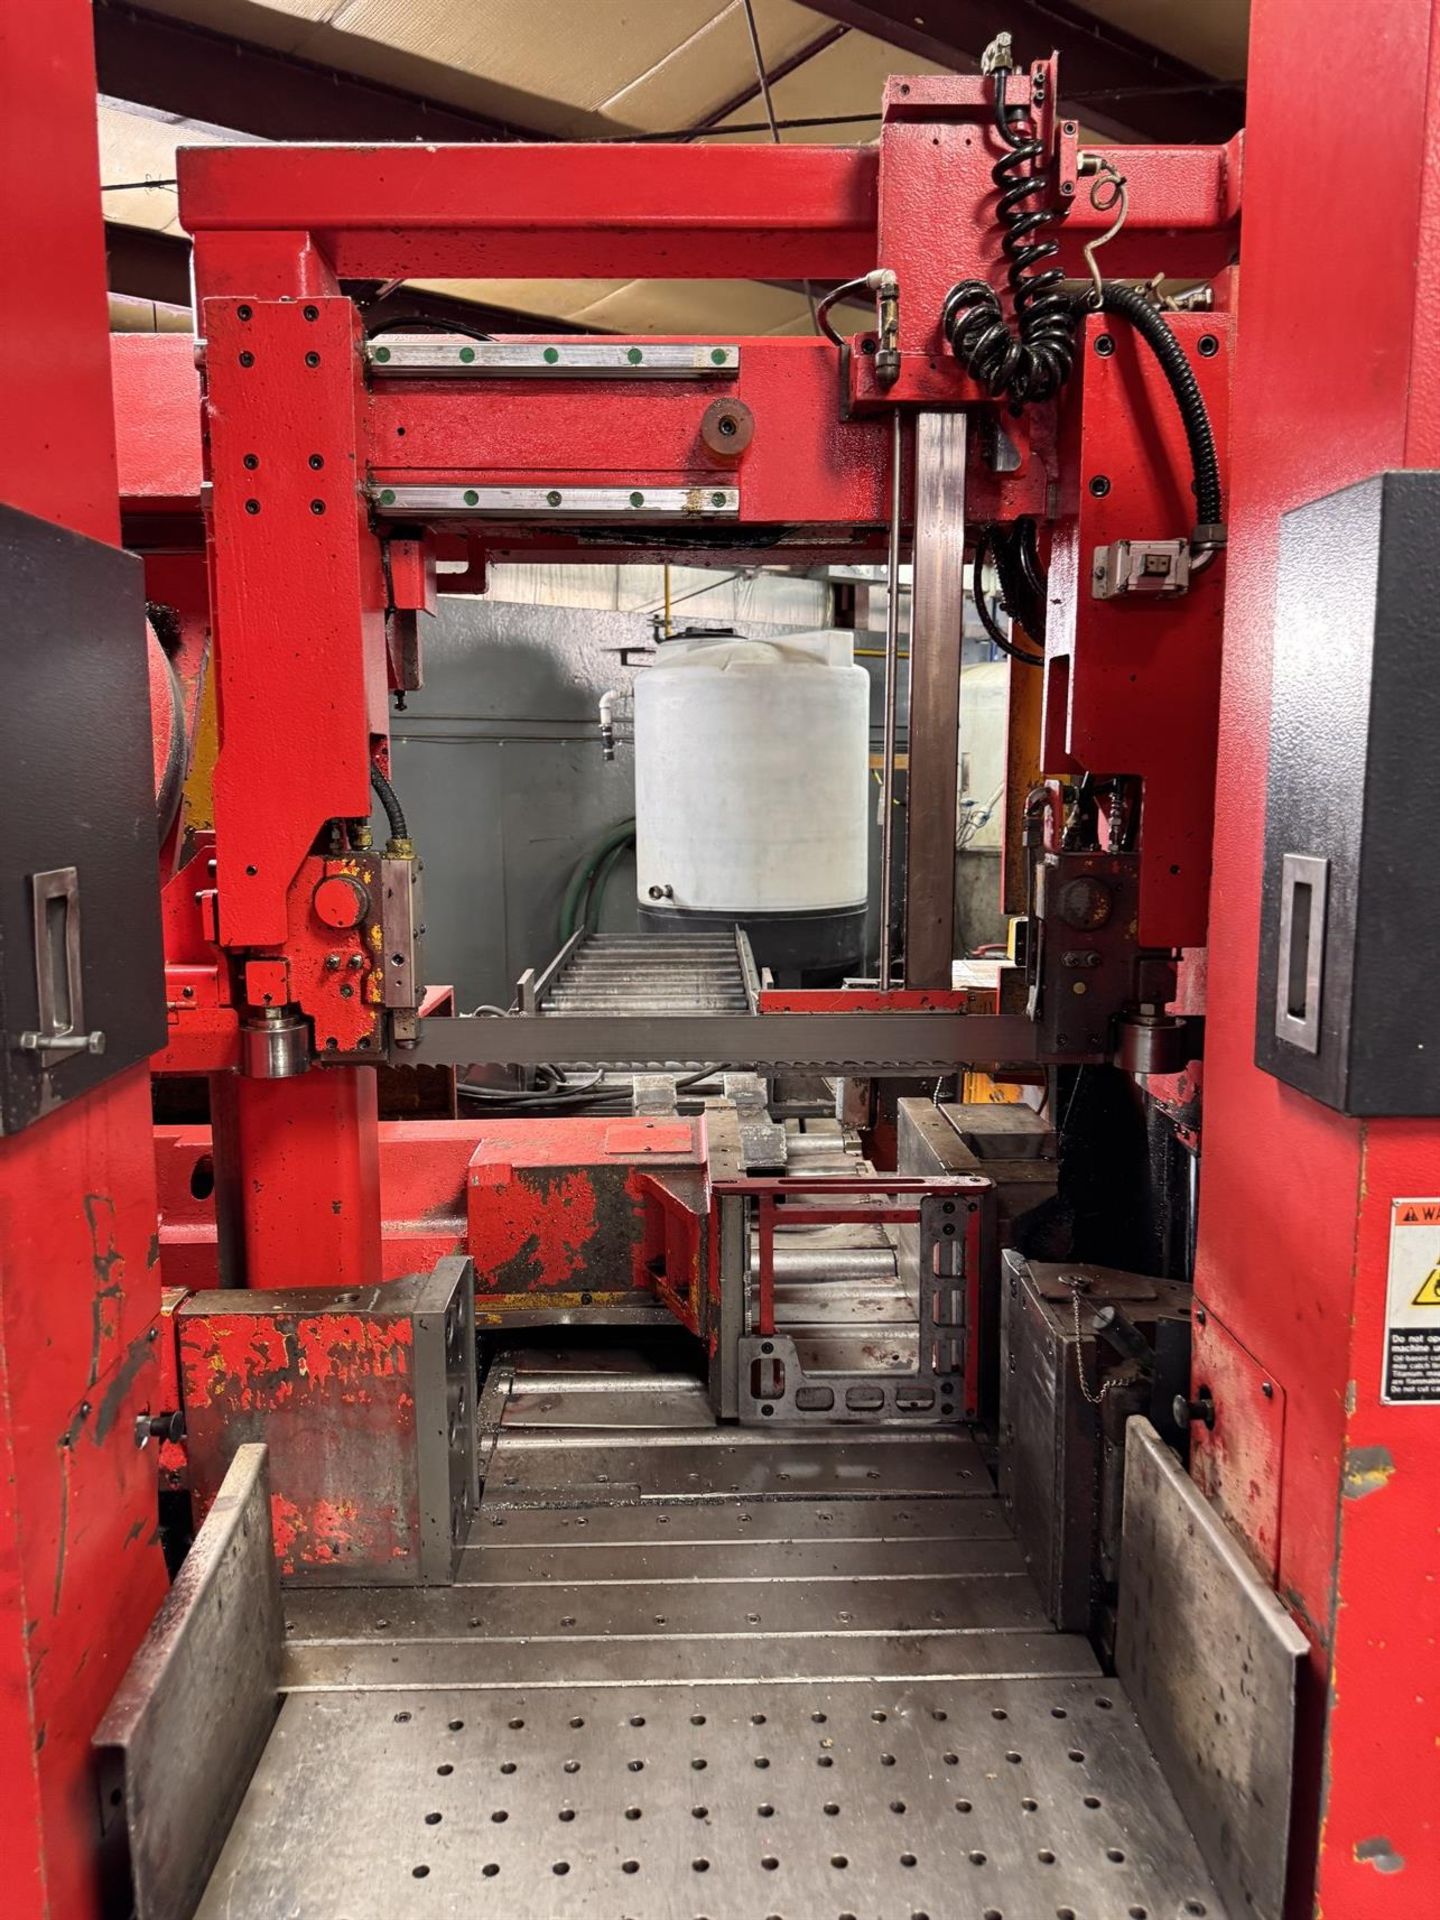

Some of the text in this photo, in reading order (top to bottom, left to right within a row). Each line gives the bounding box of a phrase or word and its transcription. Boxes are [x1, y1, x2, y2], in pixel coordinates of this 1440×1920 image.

[1392, 1335, 1405, 1343] Do
[1408, 1335, 1424, 1343] not
[1391, 1344, 1430, 1352] machine
